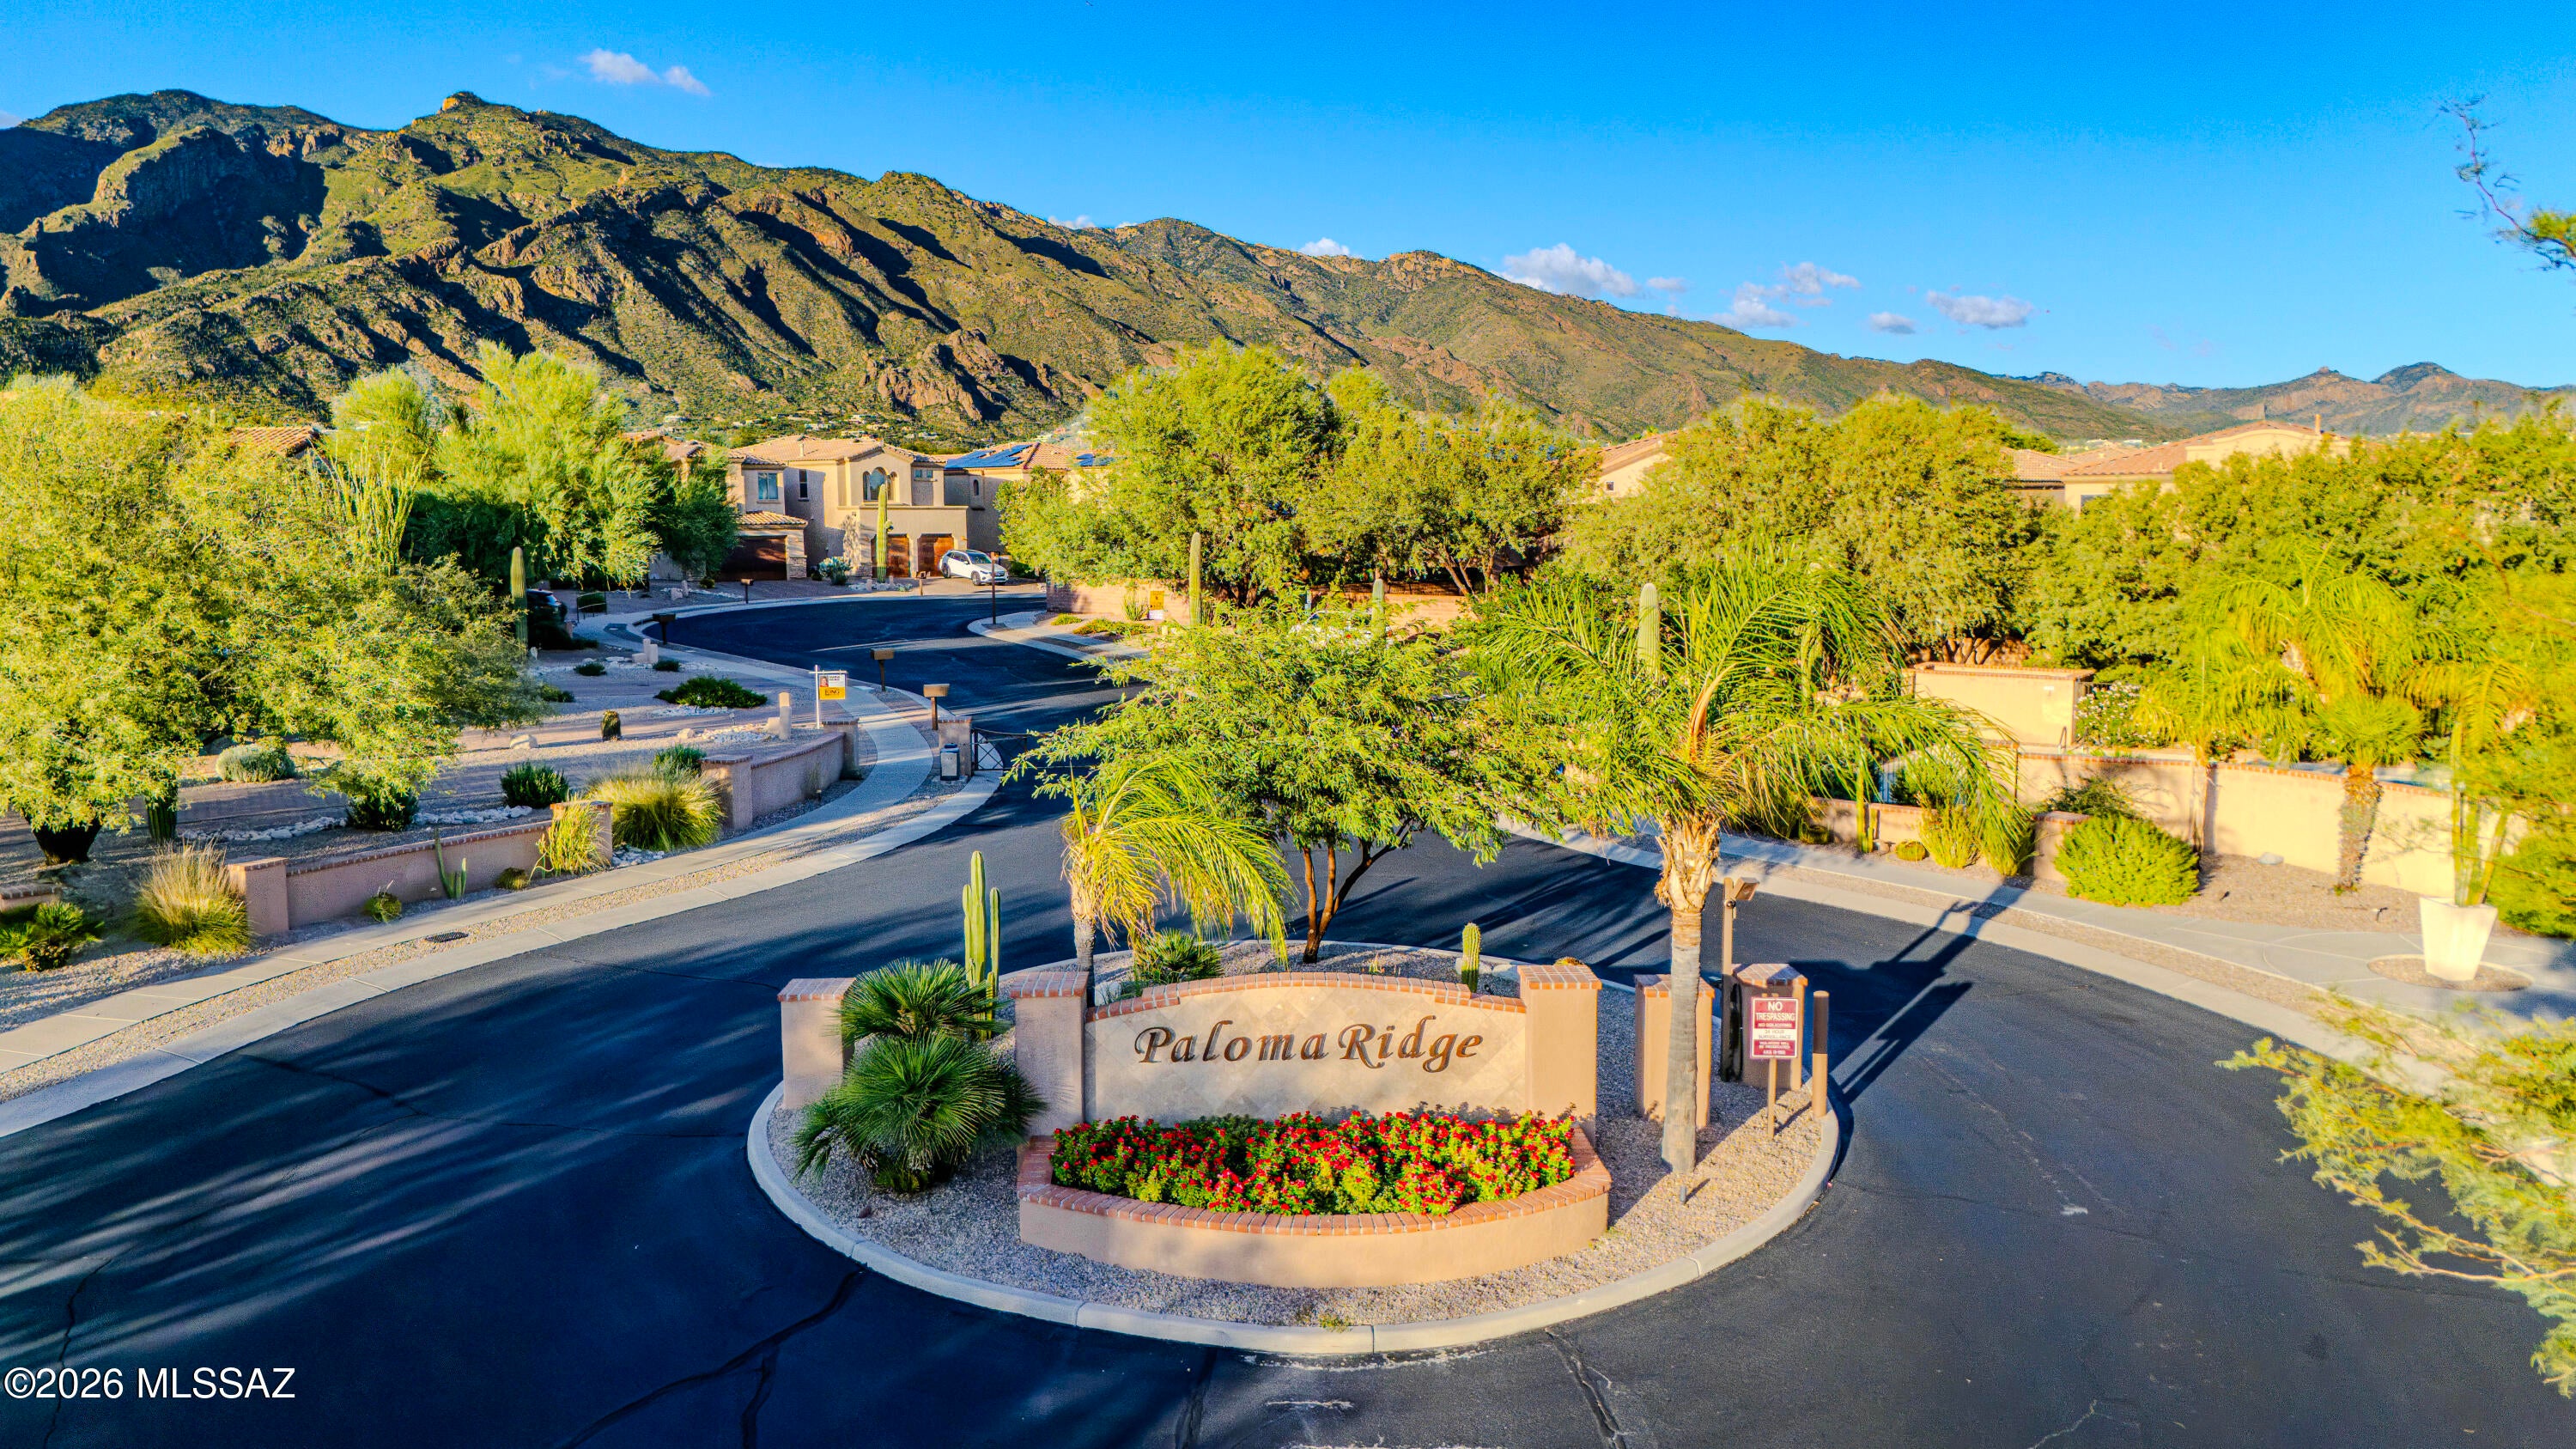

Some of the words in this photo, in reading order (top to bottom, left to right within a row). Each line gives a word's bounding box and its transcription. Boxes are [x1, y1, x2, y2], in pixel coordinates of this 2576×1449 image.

[1767, 1001, 1783, 1012] NO
[1756, 1012, 1795, 1021] TRESPASSING
[1134, 1020, 1329, 1063] Paloma
[1338, 1014, 1484, 1074] Ridge
